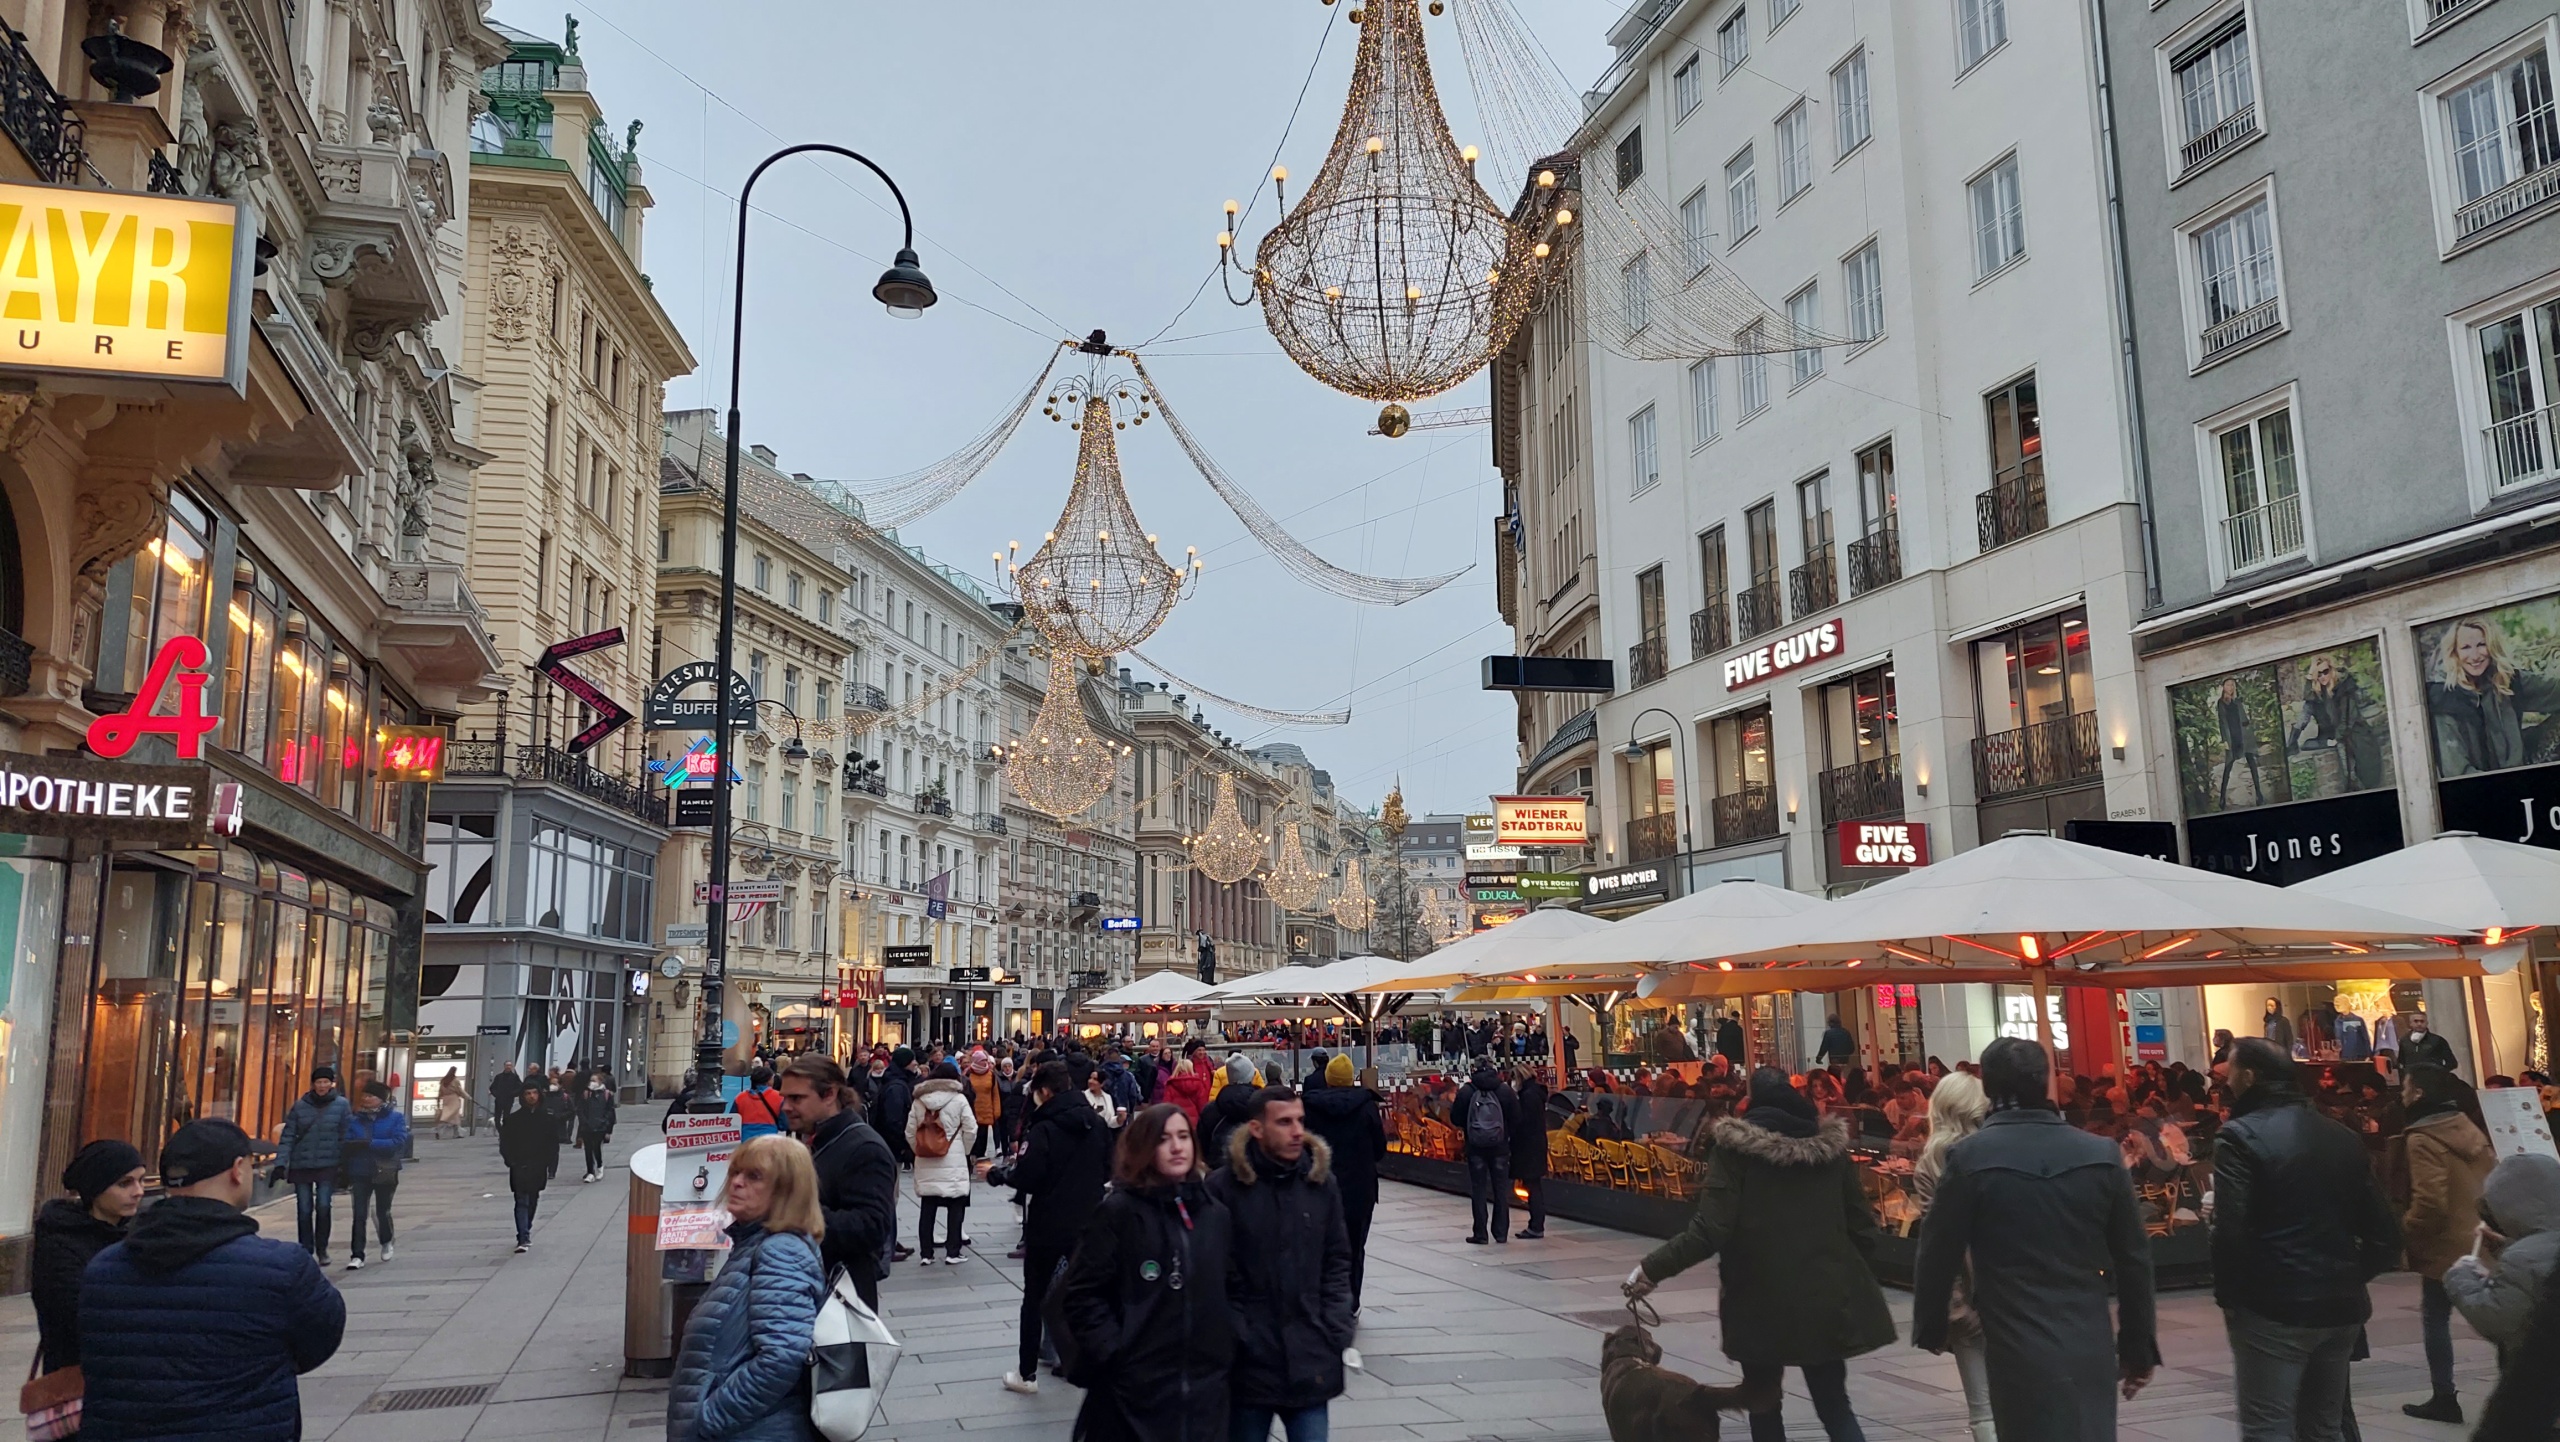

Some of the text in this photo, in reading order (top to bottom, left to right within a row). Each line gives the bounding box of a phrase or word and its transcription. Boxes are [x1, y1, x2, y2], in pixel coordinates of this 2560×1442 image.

[551, 630, 619, 654] DISCOTHEQUE
[1724, 623, 1837, 687] FIVE GUYS
[548, 667, 618, 719] FLEDERMAUS
[654, 665, 752, 712] TRZEŚNIWSKI
[672, 702, 732, 715] BUFFE
[589, 722, 609, 737] BAR
[1515, 809, 1568, 819] WIENER
[2110, 806, 2146, 820] GRABEN 30
[1501, 821, 1583, 832] STADTBRÄU
[1860, 825, 1909, 843] FIVE
[1856, 845, 1917, 863] GUYS
[2246, 831, 2343, 872] Jones
[1468, 876, 1499, 884] GERRY
[1599, 869, 1658, 890] YVES ROCHER
[1108, 919, 1137, 928] Berlitz
[838, 968, 886, 999] LISKA
[2001, 1022, 2070, 1050] GUS
[668, 1116, 732, 1129] Am Sonntag
[668, 1133, 734, 1148] ÖSTERREICH
[660, 1237, 685, 1245] ESSEN
[661, 1231, 688, 1239] GRATIS
